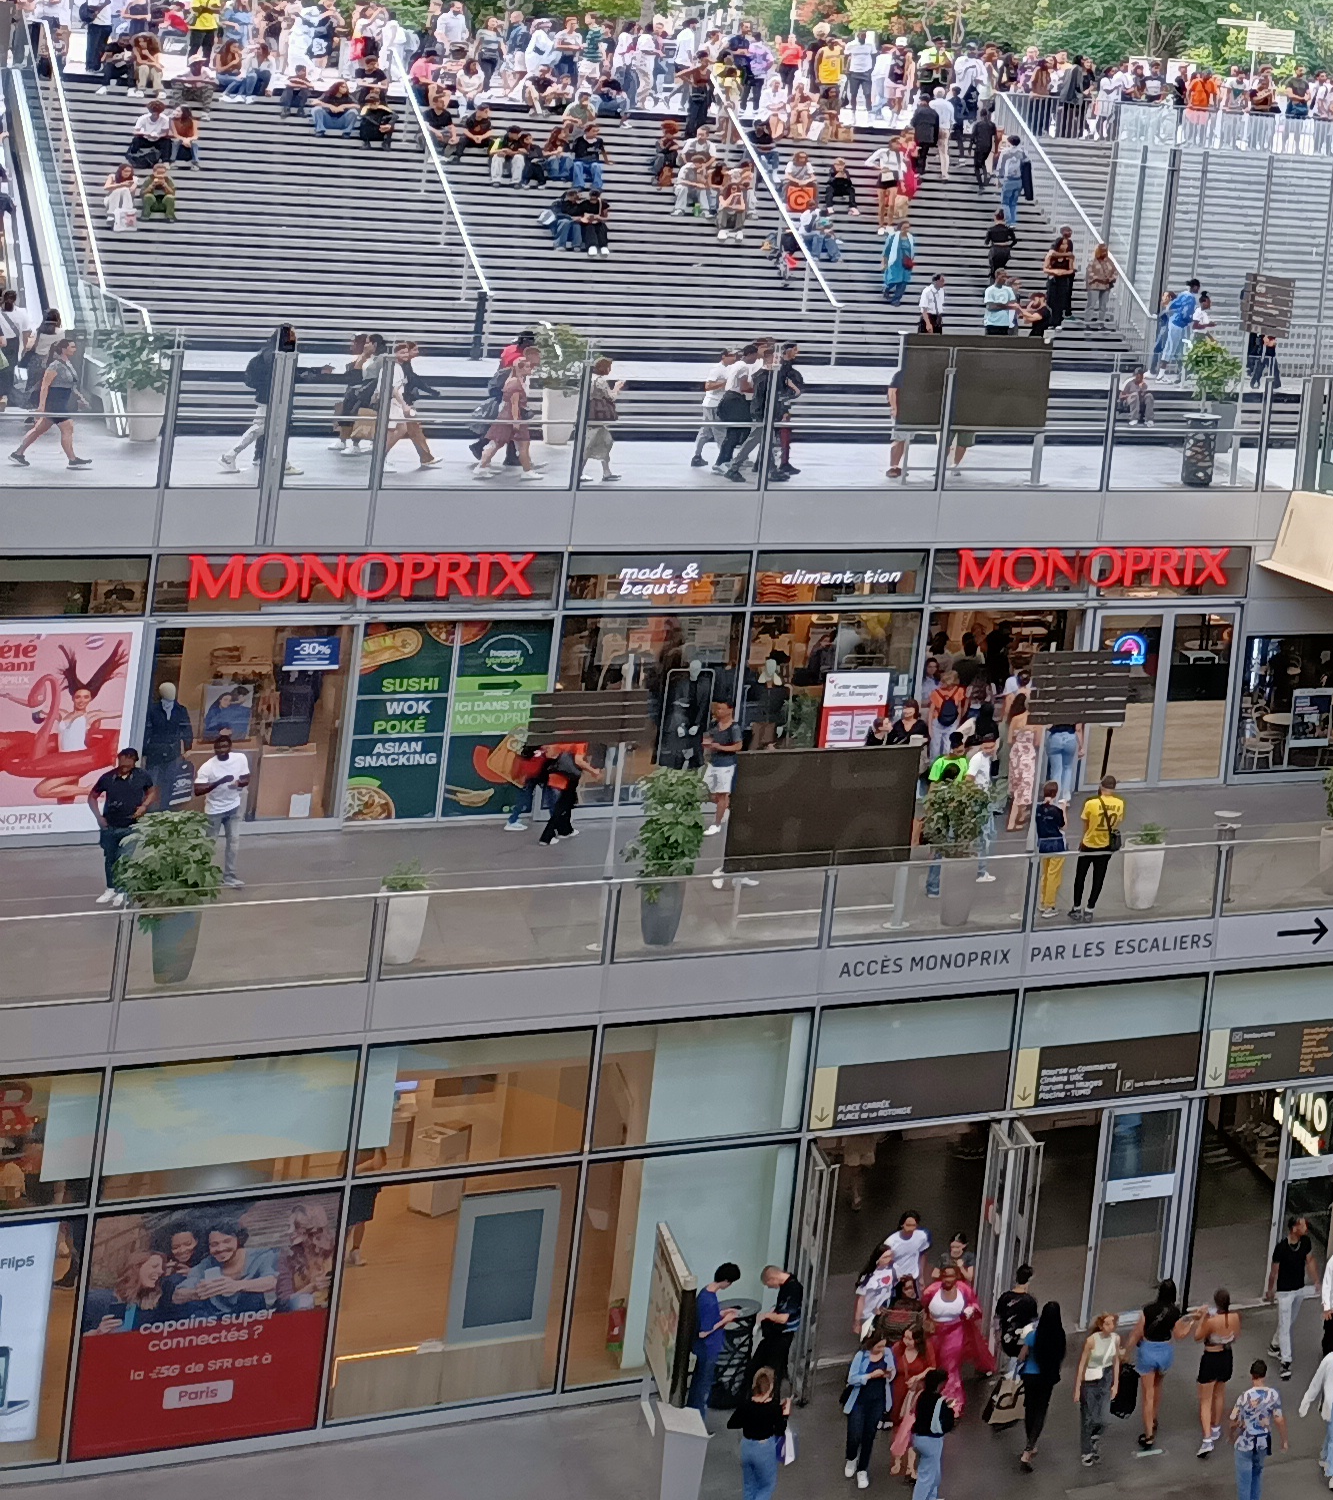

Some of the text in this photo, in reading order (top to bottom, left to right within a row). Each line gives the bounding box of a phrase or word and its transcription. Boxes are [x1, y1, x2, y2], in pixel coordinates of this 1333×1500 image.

[188, 553, 536, 599] MONOPRIX
[619, 562, 700, 581] mode &
[780, 568, 903, 586] alimentation
[958, 547, 1231, 590] MONOPRIX
[619, 577, 691, 596] beauté
[294, 642, 332, 655] -30%
[382, 677, 440, 693] SUSHI
[386, 700, 434, 715] WOK
[454, 700, 531, 712] ICI DANS TO
[373, 716, 428, 735] POKÉ
[372, 740, 424, 755] ASIAN
[354, 753, 438, 768] SNACKING
[838, 932, 1214, 978] ACCÈS MONOPRIX PAR LES ESCALIERS
[139, 1307, 277, 1337] copains super
[148, 1324, 264, 1352] connectés ?
[130, 1368, 145, 1381] la
[184, 1362, 204, 1374] de
[207, 1358, 233, 1372] SFR
[234, 1353, 259, 1368] est
[261, 1352, 273, 1365] à
[177, 1386, 219, 1402] Paris
